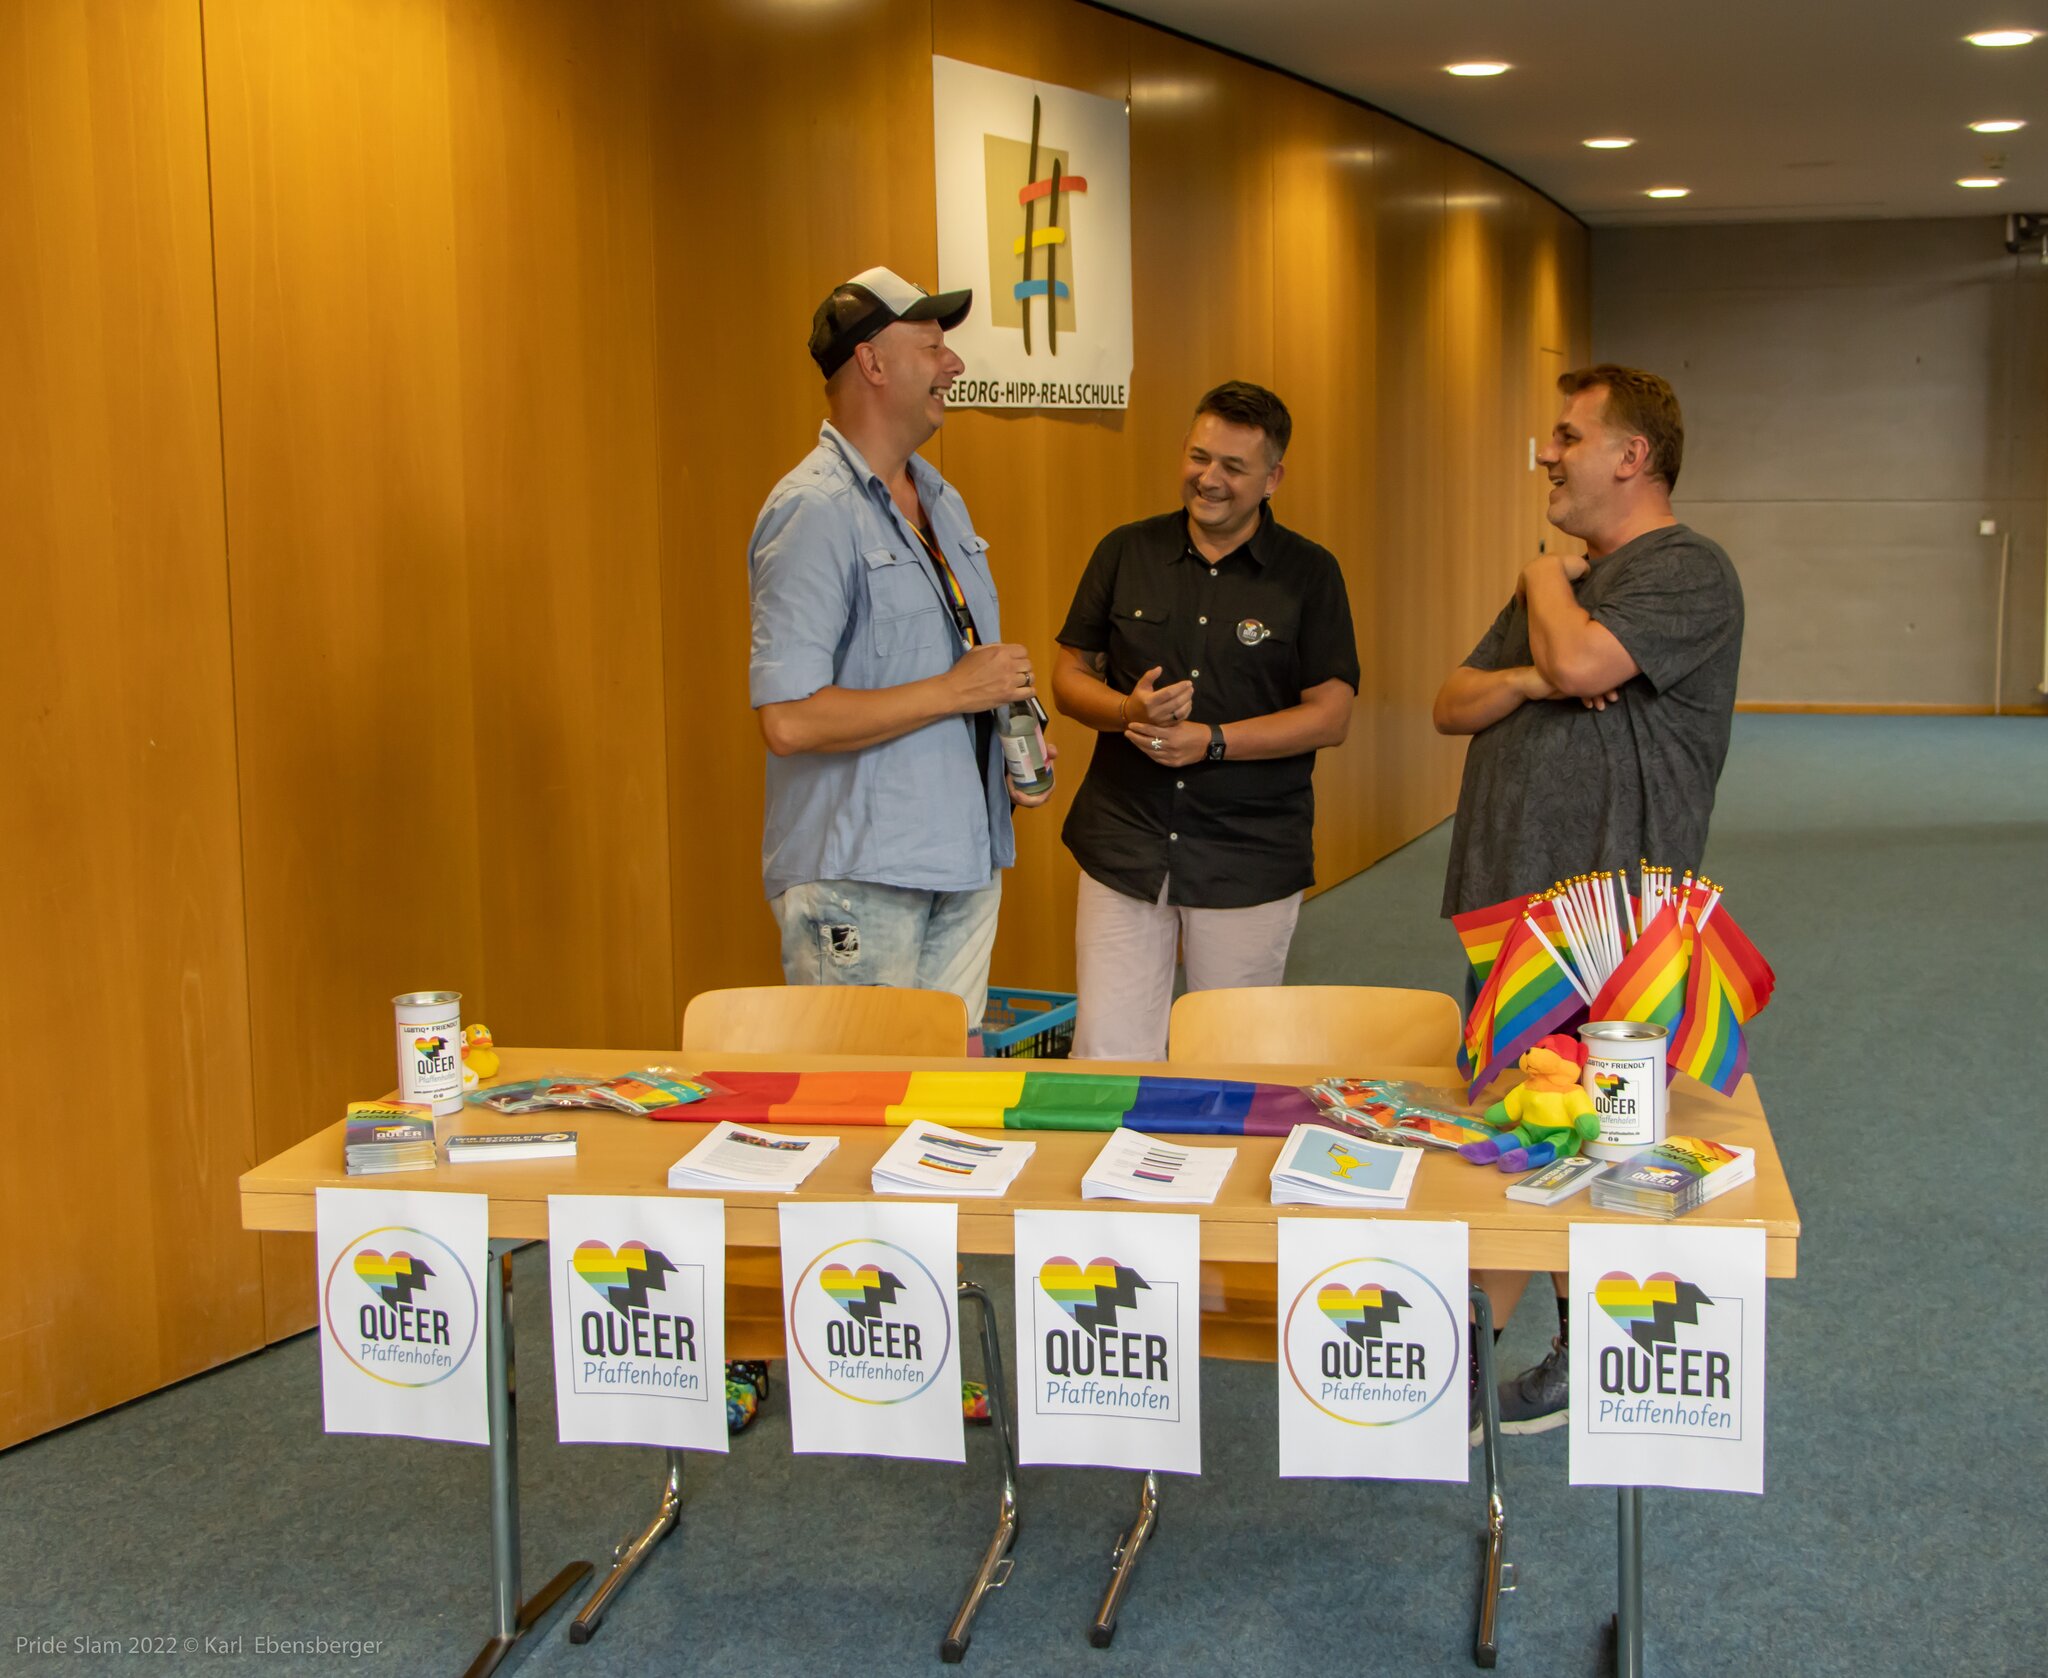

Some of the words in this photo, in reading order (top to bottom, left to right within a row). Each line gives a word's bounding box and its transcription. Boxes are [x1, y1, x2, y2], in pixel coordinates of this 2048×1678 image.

[946, 380, 1125, 405] GEORG-HIPP-REALSCHULE
[417, 1055, 455, 1075] QUEER
[1595, 1096, 1636, 1115] QUEER
[376, 1129, 422, 1139] QUEER
[1659, 1143, 1719, 1163] PRIDE
[1631, 1171, 1680, 1186] QUEER
[360, 1303, 450, 1346] QUEER
[581, 1309, 697, 1362] QUEER
[826, 1318, 922, 1361] QUEER
[361, 1343, 452, 1367] Pfaffenhofen
[1045, 1327, 1169, 1382] QUEER
[1321, 1338, 1426, 1380] QUEER
[583, 1361, 699, 1390] Pfaffenhofen
[828, 1360, 924, 1383] Pfaffenhofen
[1599, 1343, 1731, 1399] QUEER
[1046, 1380, 1170, 1410] Pfaffenhofen
[1321, 1381, 1427, 1403] Pfaffenhofen
[1599, 1399, 1731, 1428] Pfaffenhofen
